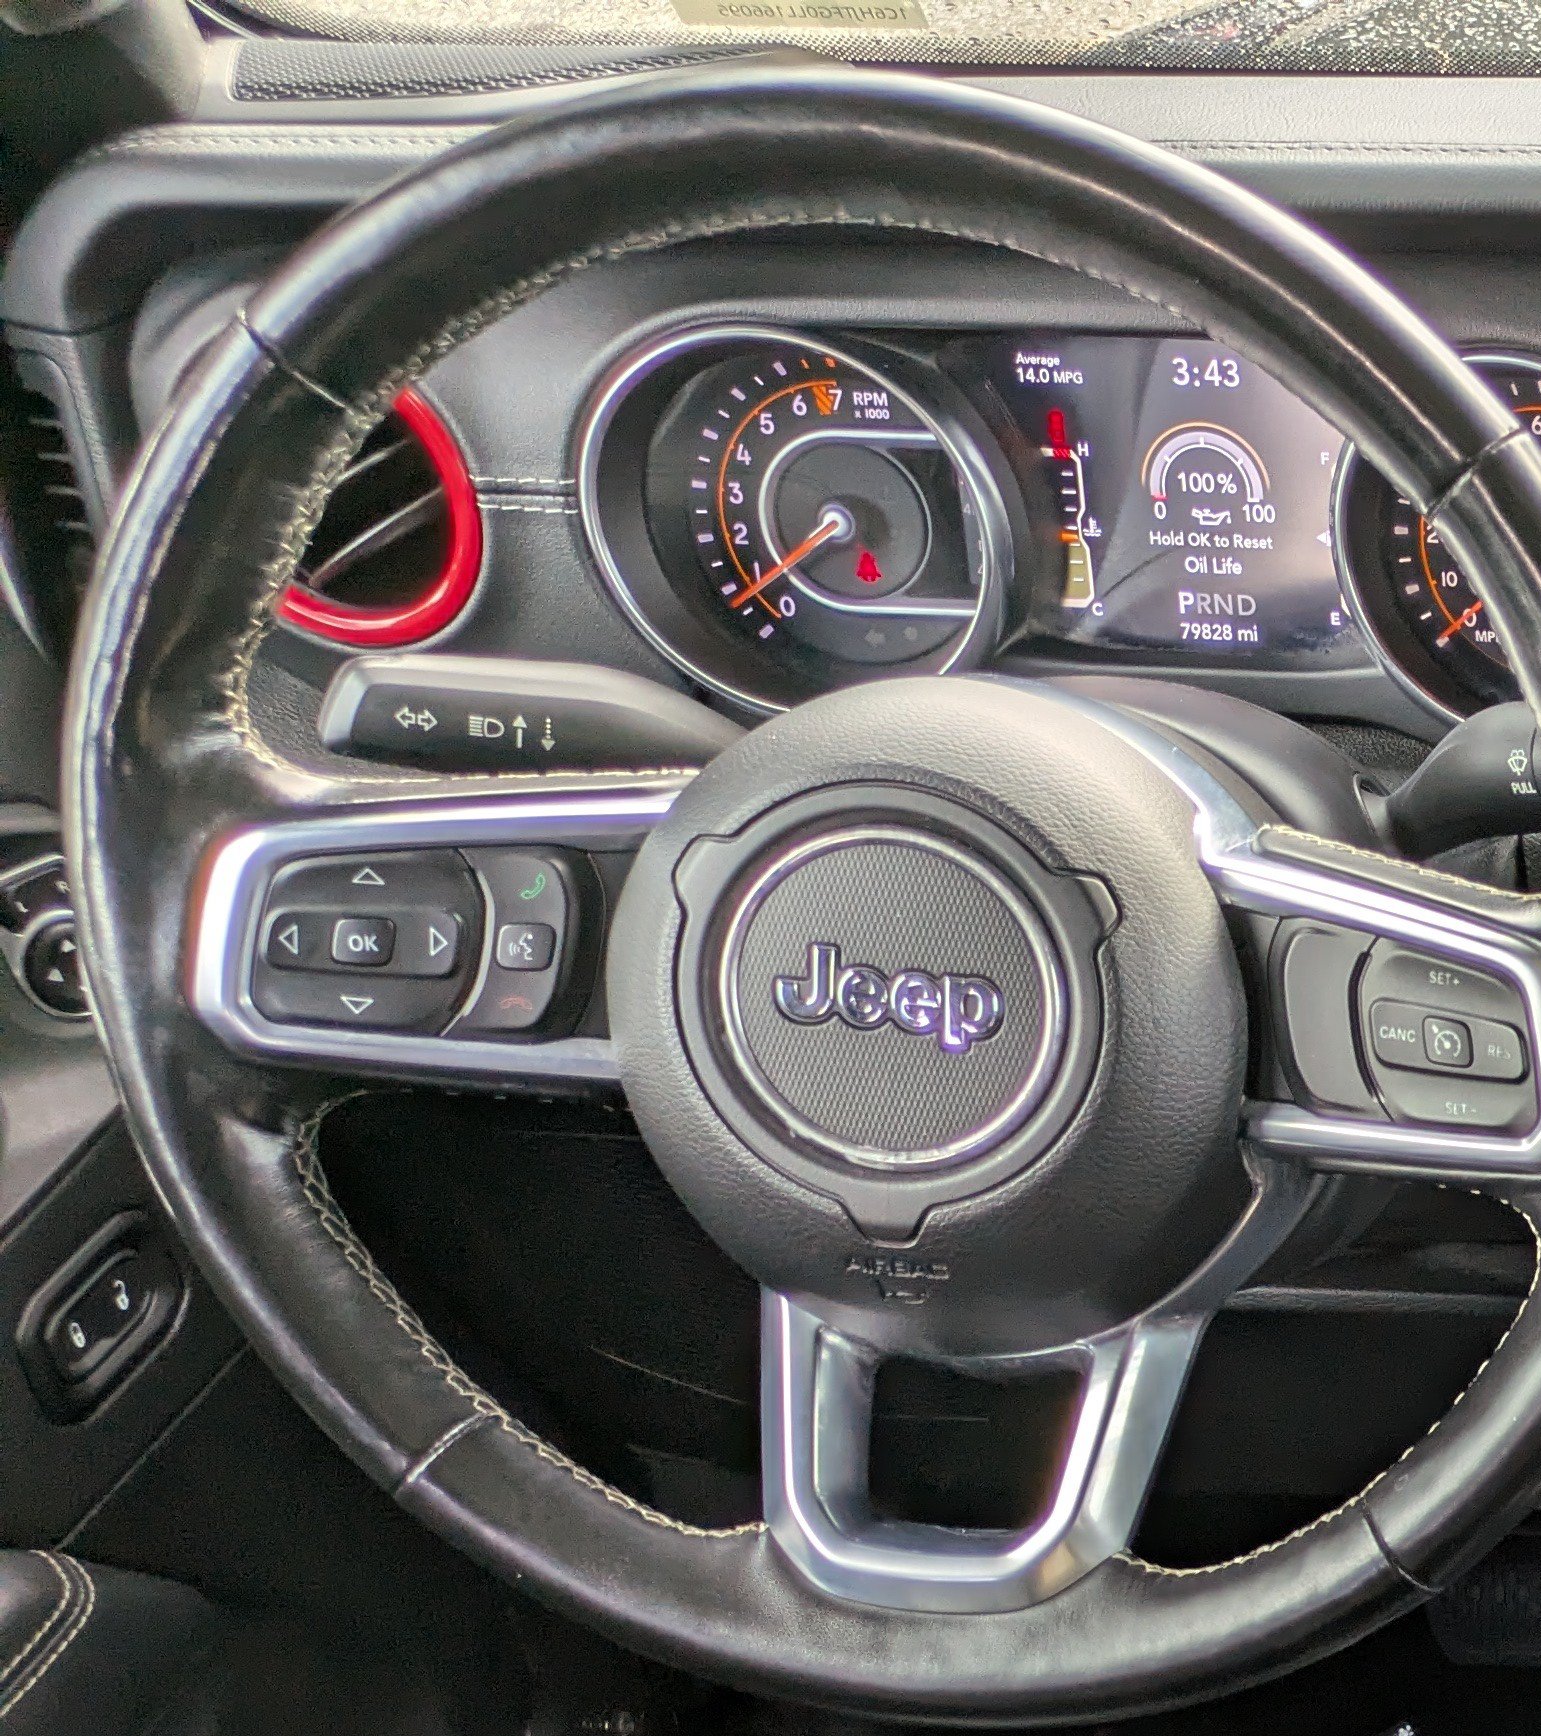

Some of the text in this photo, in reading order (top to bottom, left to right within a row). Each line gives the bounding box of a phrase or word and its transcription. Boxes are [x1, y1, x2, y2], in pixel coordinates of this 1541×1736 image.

[1015, 352, 1060, 366] Average
[1016, 368, 1083, 385] 14.0 MPG
[1171, 357, 1240, 388] 3:43
[792, 395, 807, 417] 6
[829, 389, 843, 410] 7
[852, 391, 889, 407] RPM
[864, 408, 890, 420] 1000
[759, 413, 774, 435] 5
[736, 444, 752, 466] 4
[1077, 444, 1089, 457] H
[1320, 452, 1330, 465] F
[728, 482, 744, 504] 3
[1177, 472, 1238, 495] 100%
[1153, 502, 1167, 520] 0
[1241, 504, 1276, 524] 100
[733, 524, 749, 546] 2
[1150, 531, 1273, 550] Hold OK to Reset
[1184, 556, 1242, 575] Oil Life
[1441, 571, 1458, 588] 10
[779, 595, 795, 617] 0
[1092, 603, 1104, 616] C
[1178, 592, 1257, 616] PRND
[1330, 613, 1341, 626] E
[1180, 622, 1259, 642] 79828 mi
[347, 933, 380, 952] OK
[773, 941, 1006, 1054] Jeep
[1379, 1026, 1416, 1043] CANC
